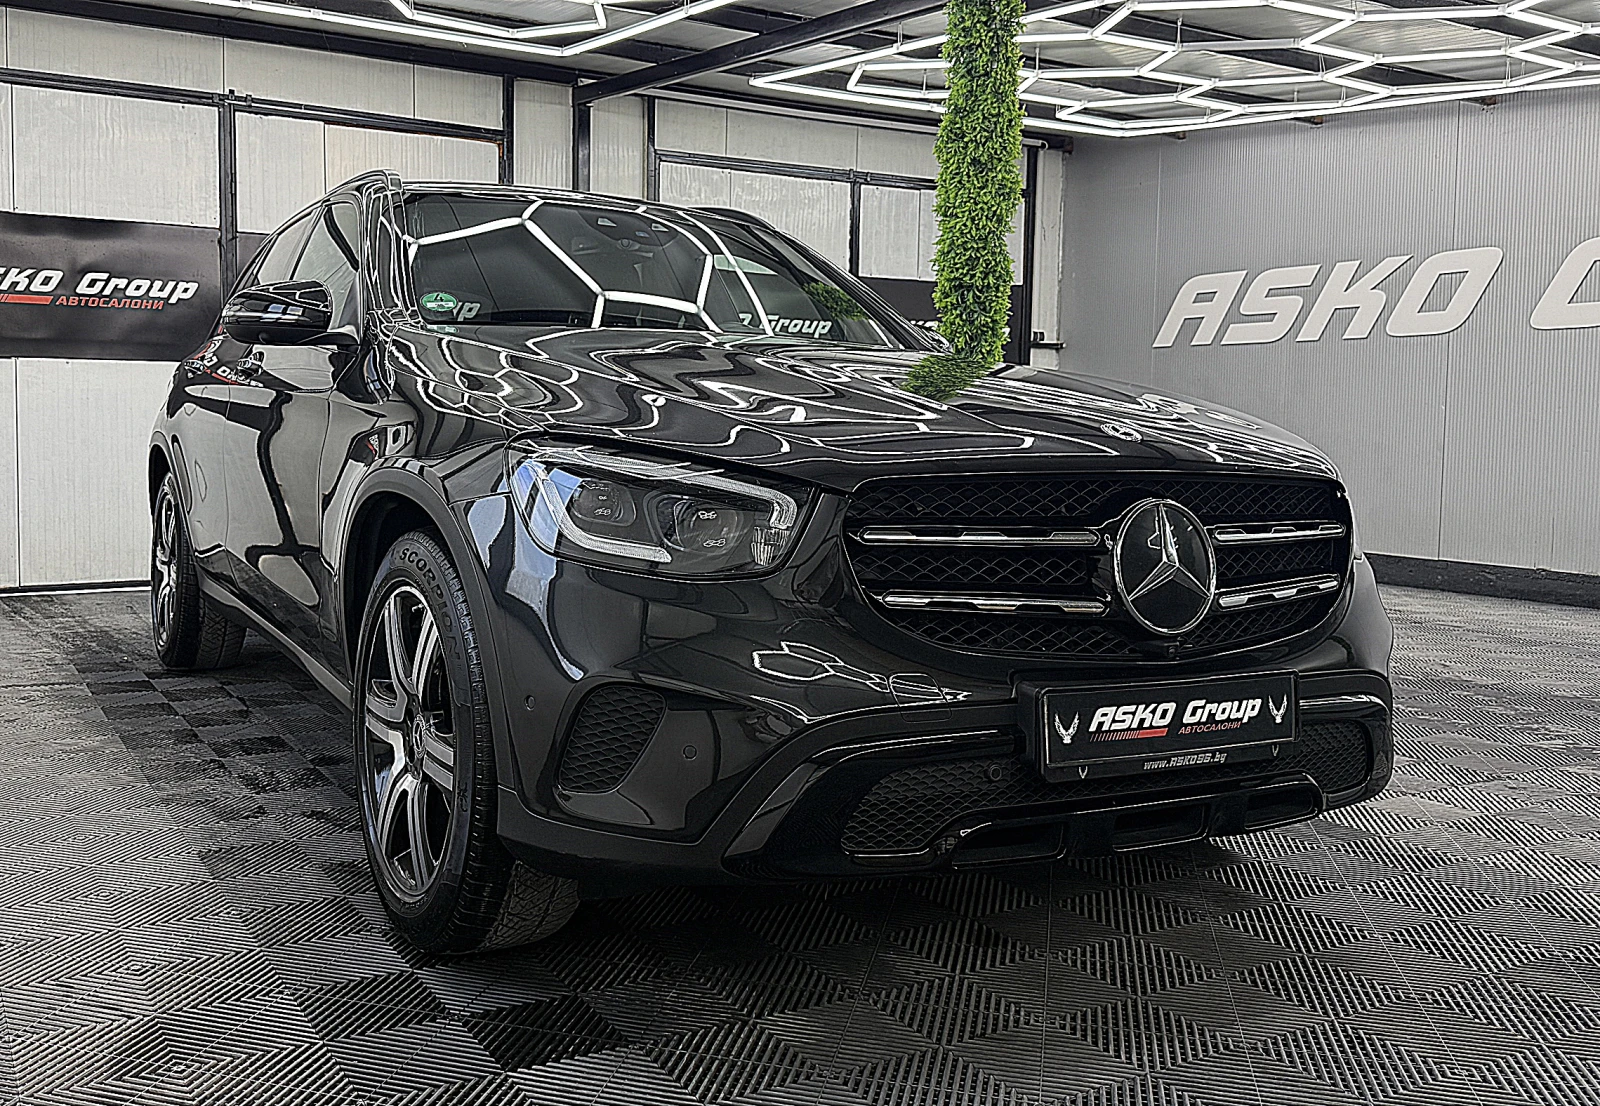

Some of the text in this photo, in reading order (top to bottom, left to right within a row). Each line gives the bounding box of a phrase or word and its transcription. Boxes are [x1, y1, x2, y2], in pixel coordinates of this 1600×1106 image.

[0, 267, 199, 304] KO Group
[55, 295, 164, 310] АВТОСАЛОНИ
[1152, 246, 1504, 348] ASKO
[400, 547, 461, 660] SCORPION
[1088, 698, 1262, 732] ASKO Group
[1178, 721, 1241, 735] АВТОСАЛОНИ
